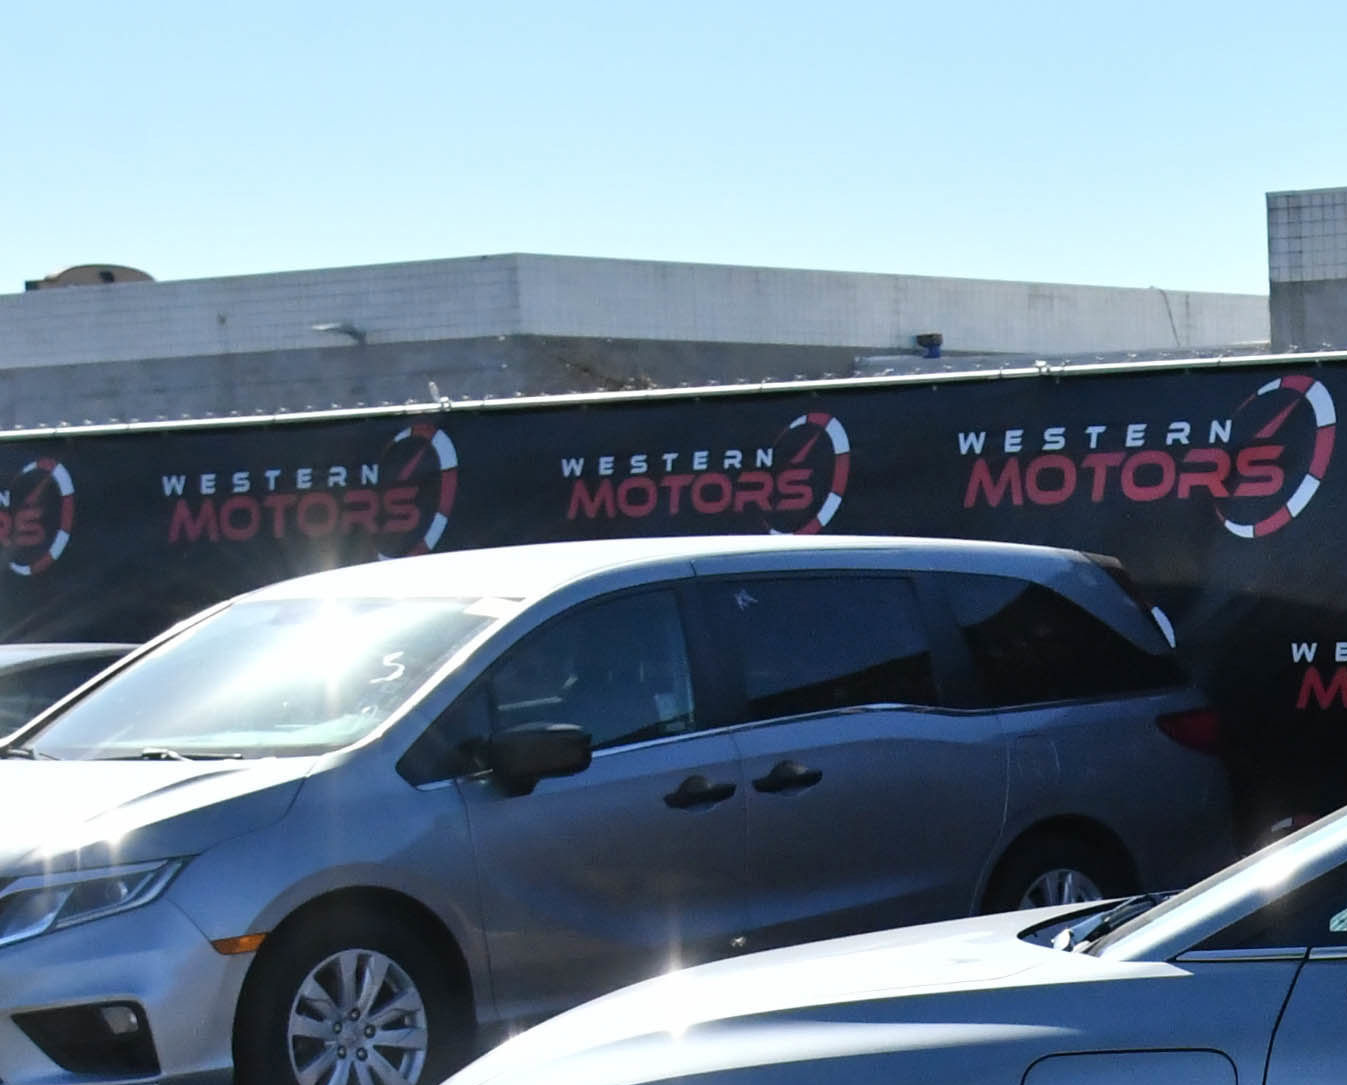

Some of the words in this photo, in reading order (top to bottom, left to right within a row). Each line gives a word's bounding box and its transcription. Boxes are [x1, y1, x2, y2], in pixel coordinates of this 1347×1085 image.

[959, 420, 1232, 454] WESTERN
[163, 465, 378, 496] WESTERN
[562, 449, 772, 476] WESTERN
[964, 445, 1284, 508] MOTORS
[168, 488, 419, 541] MOTORS
[568, 469, 813, 520] MOTORS
